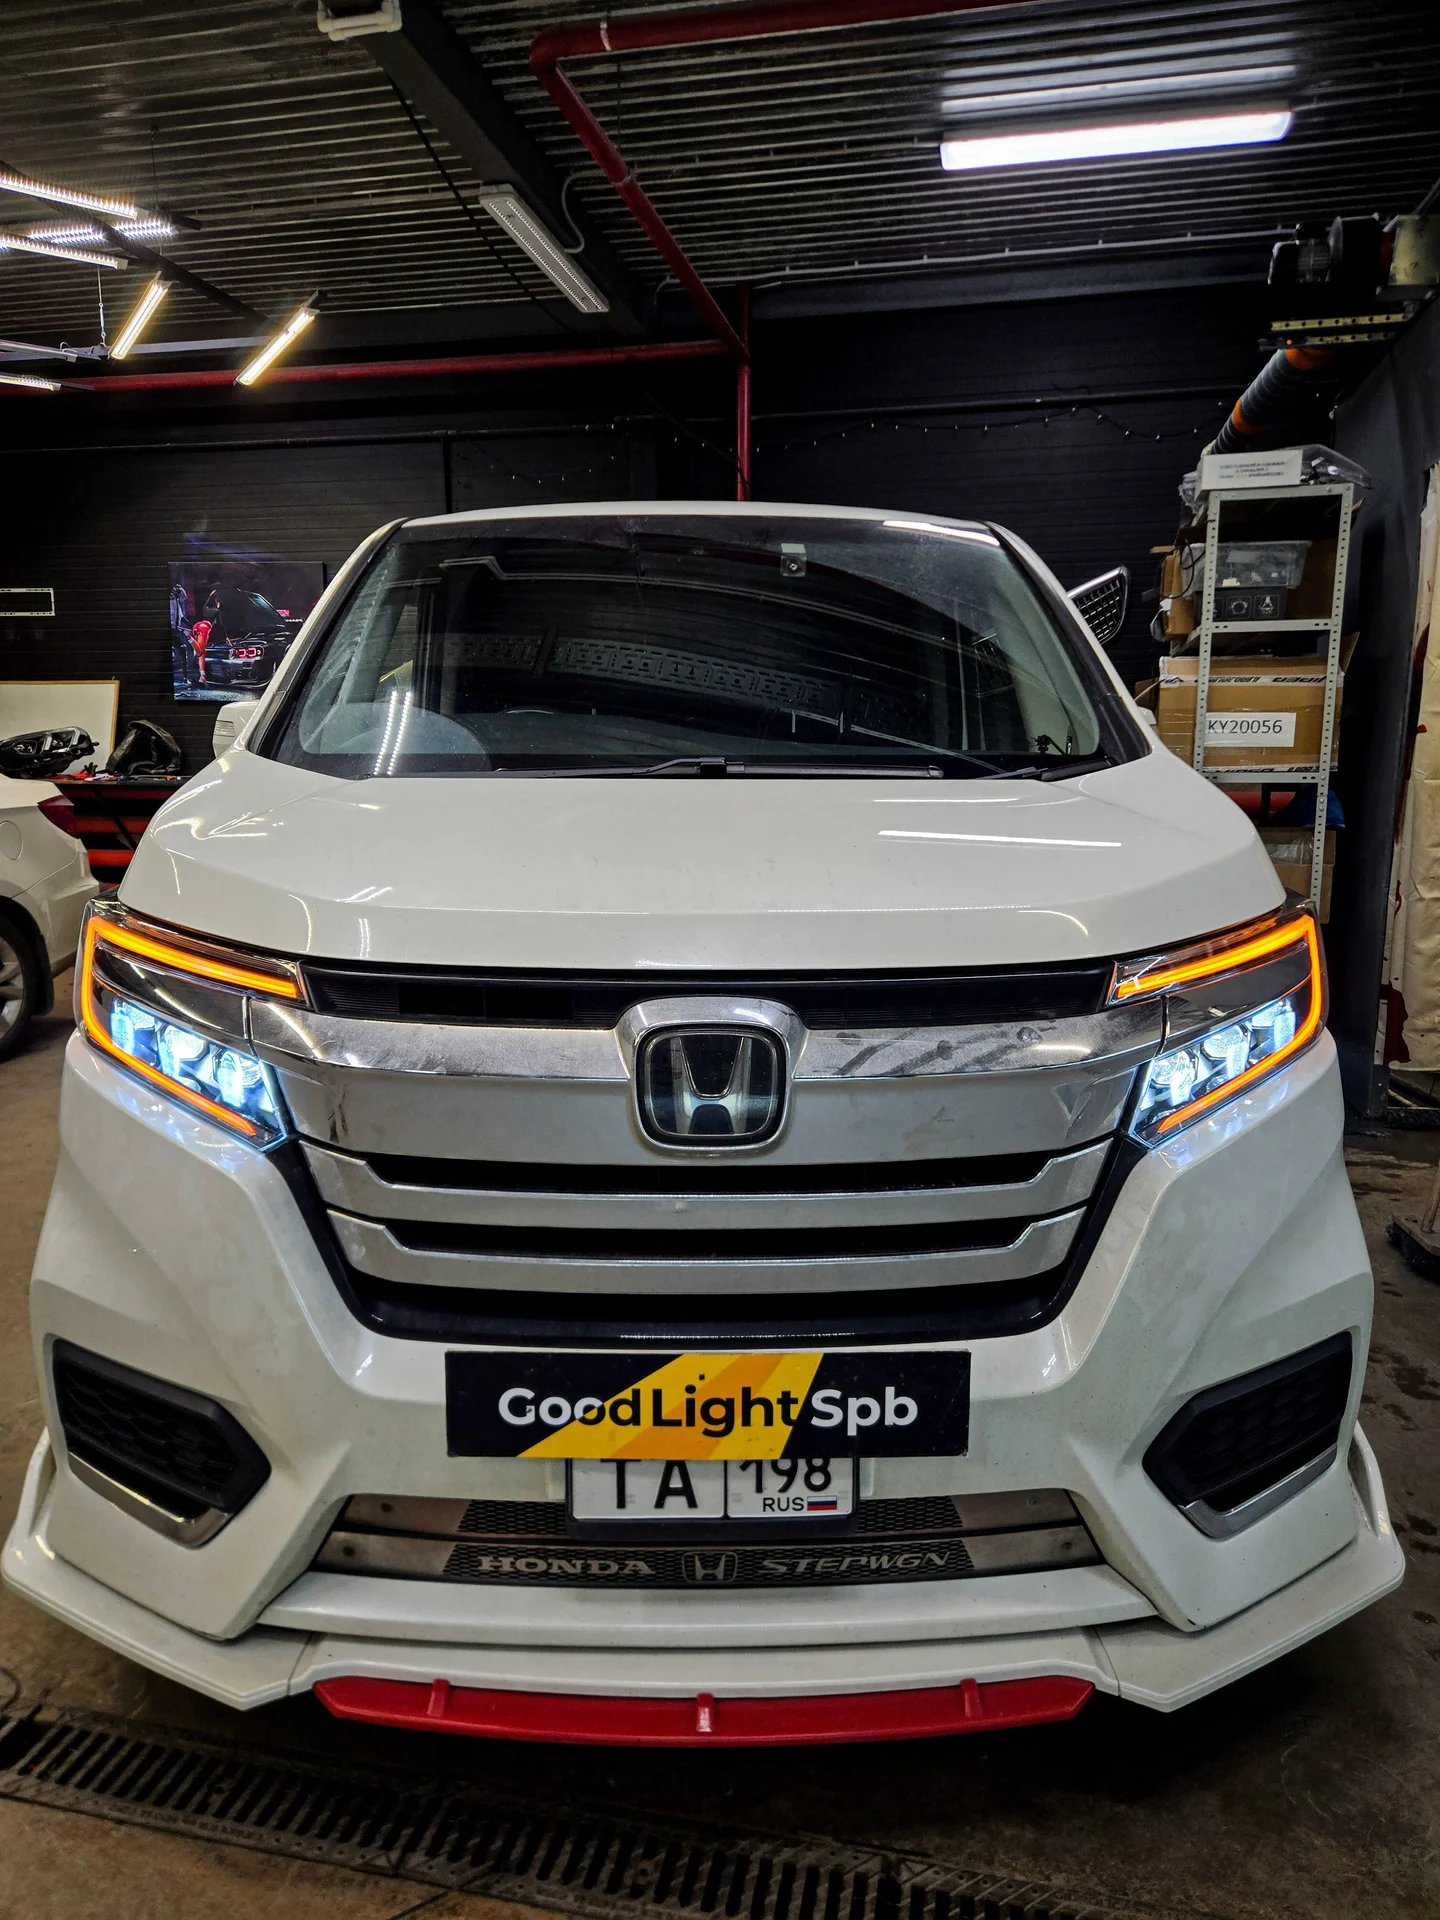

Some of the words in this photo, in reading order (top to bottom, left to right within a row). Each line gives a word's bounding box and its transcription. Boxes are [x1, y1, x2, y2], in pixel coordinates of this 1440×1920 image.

[1207, 719, 1283, 734] KY20056
[739, 1458, 832, 1493] 198
[762, 1496, 804, 1512] RUS
[478, 1556, 656, 1575] HONDA
[758, 1551, 950, 1573] STEPWGN
